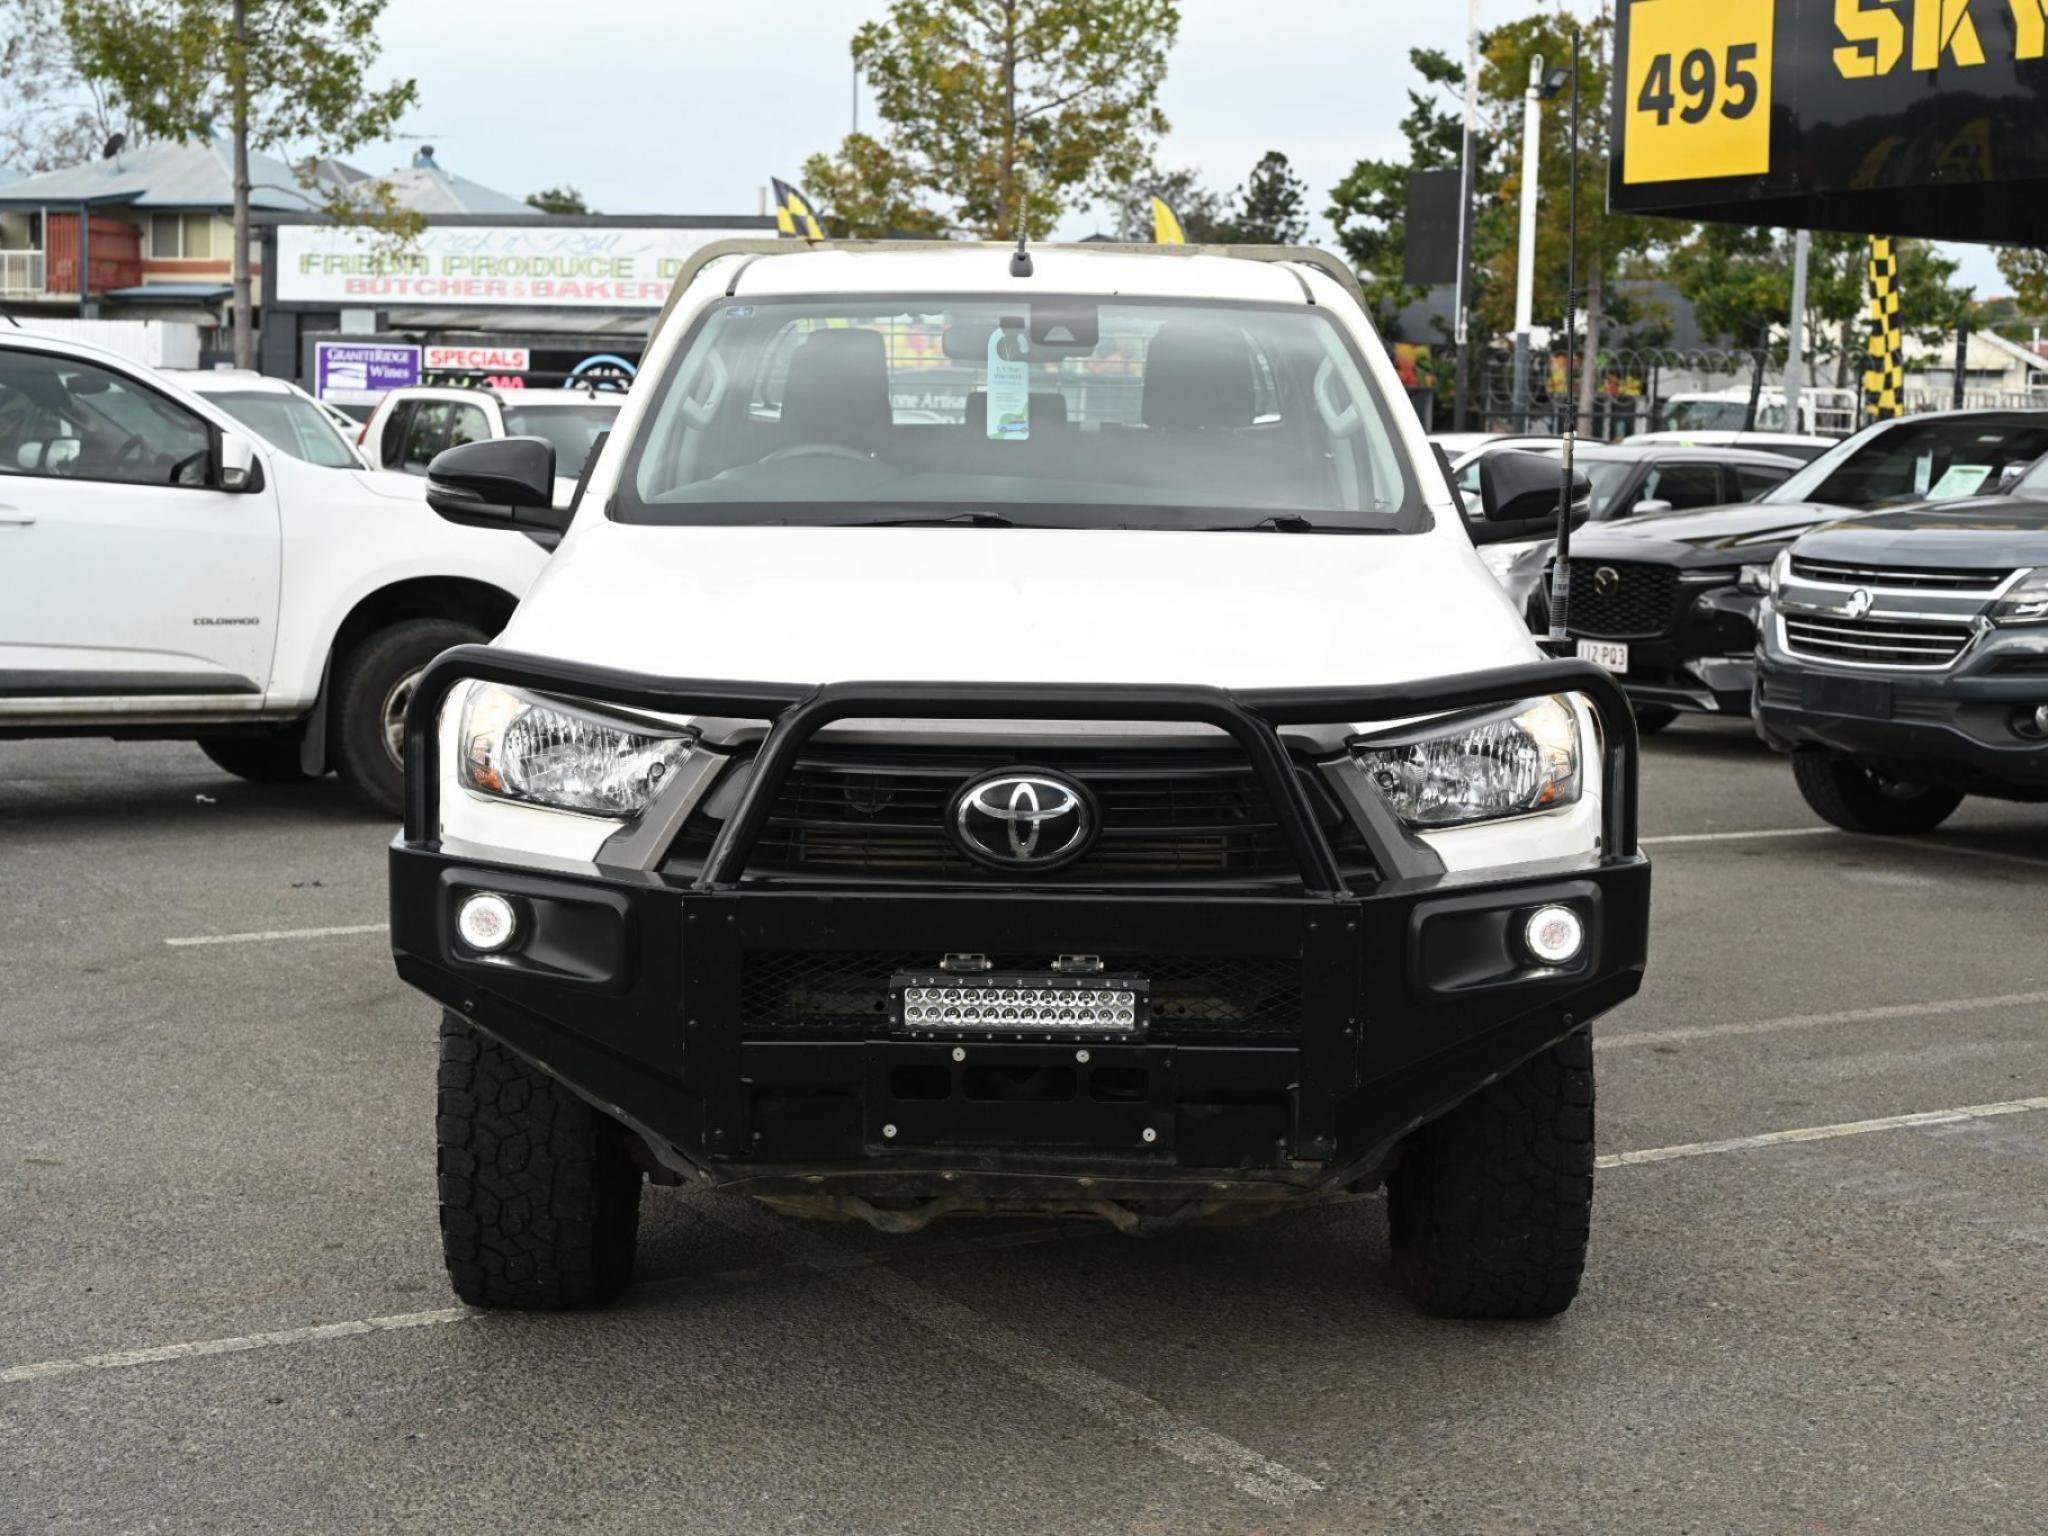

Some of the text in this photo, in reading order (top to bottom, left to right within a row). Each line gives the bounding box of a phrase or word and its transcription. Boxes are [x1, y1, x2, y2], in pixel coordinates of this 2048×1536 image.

[1637, 42, 1758, 126] 495
[442, 256, 634, 278] PRODUCE
[345, 278, 506, 297] BUTCHER
[430, 350, 524, 368] SPECIALS
[193, 616, 260, 626] COLORADO
